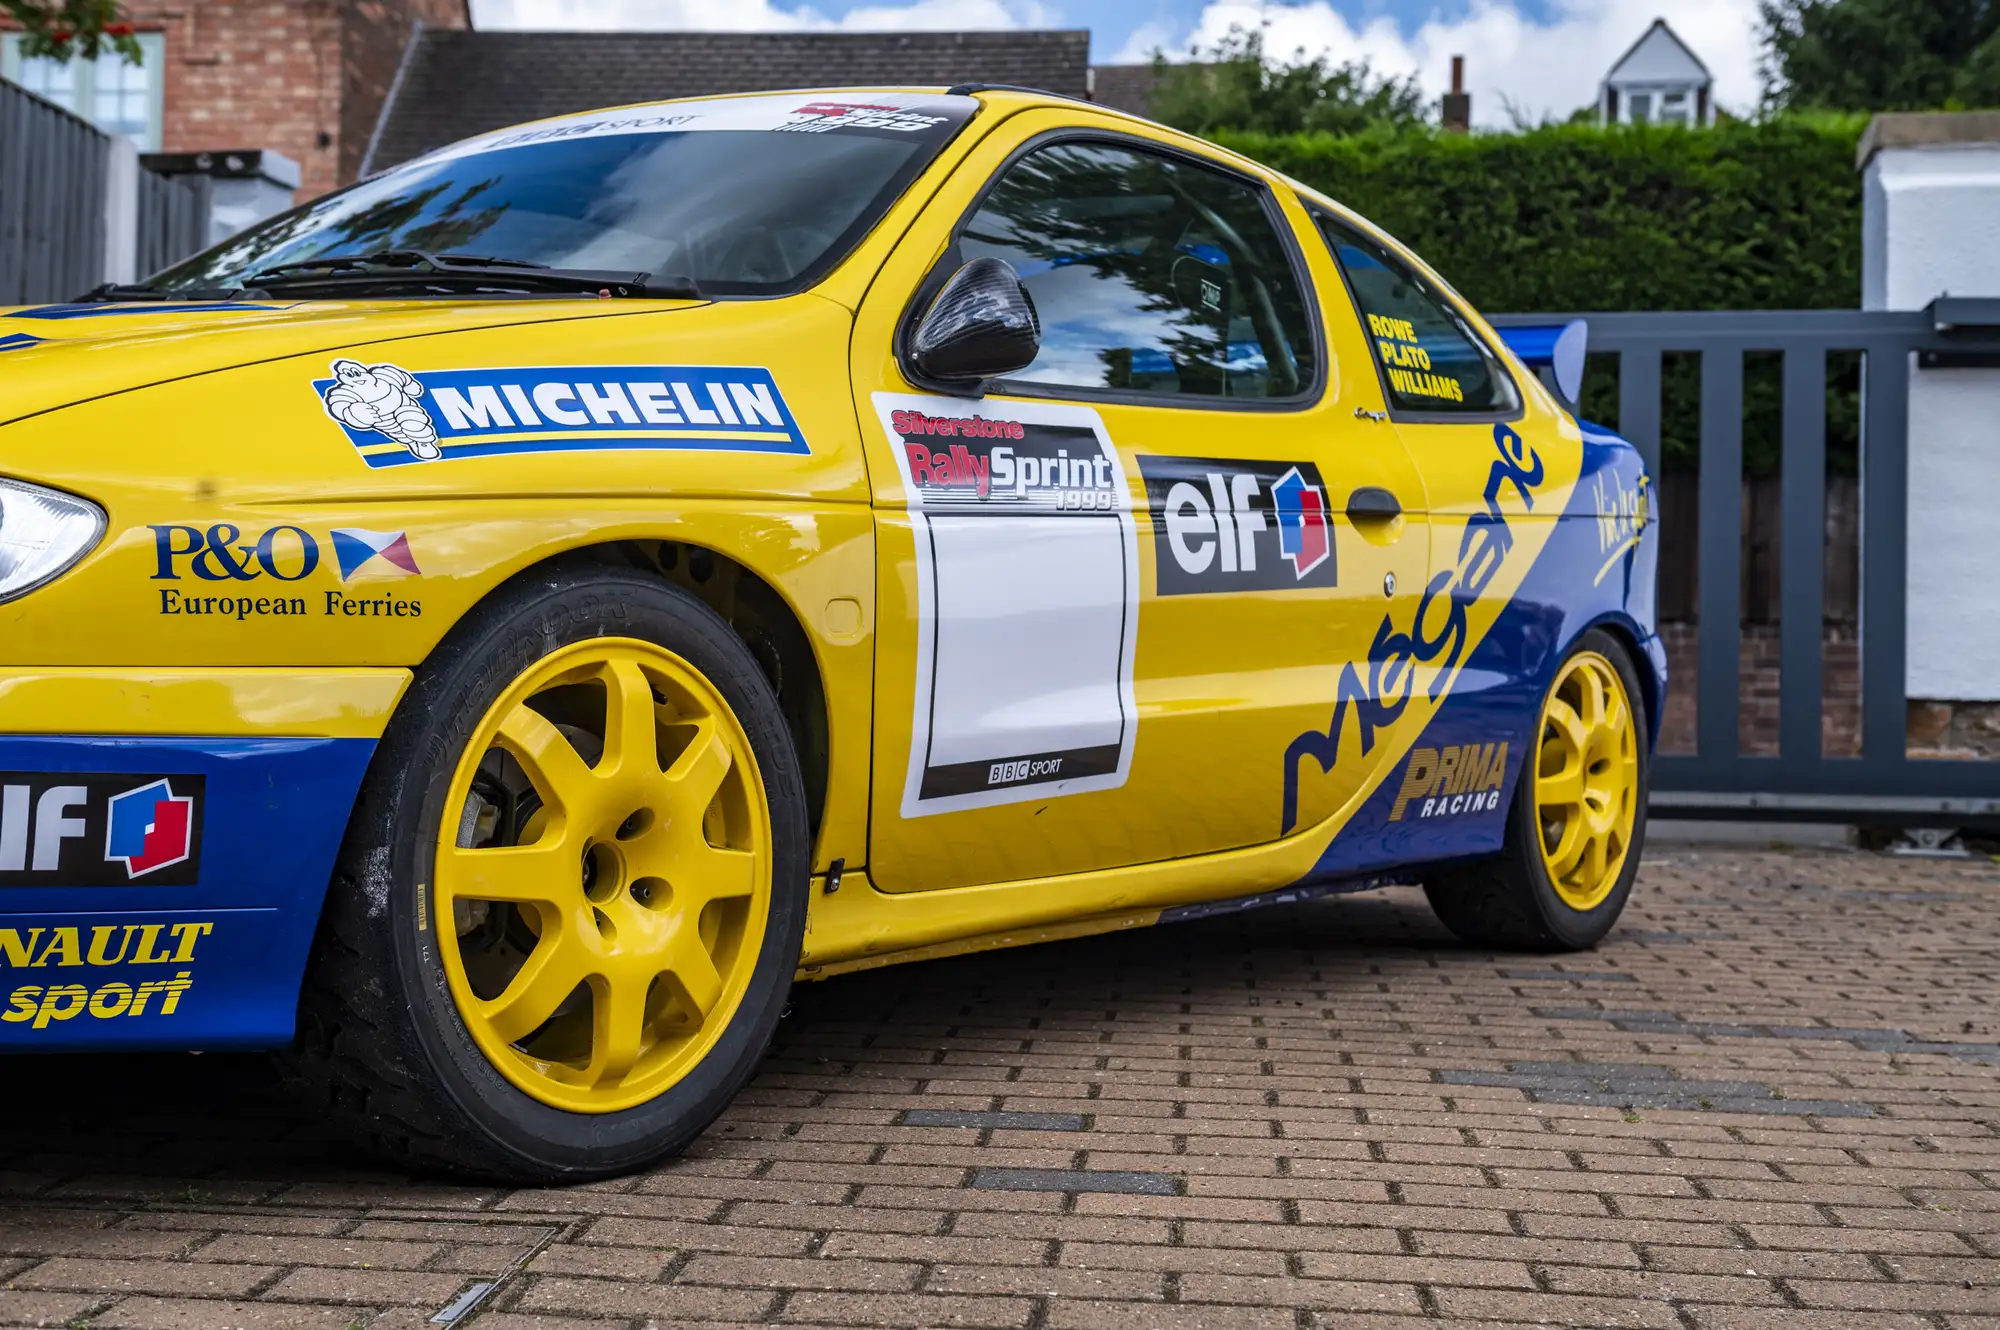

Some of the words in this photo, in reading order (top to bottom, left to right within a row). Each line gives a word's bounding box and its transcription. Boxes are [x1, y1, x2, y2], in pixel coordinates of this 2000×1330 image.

[1368, 314, 1418, 343] ROWE
[1379, 341, 1431, 371] PLATO
[1388, 368, 1463, 402] WILLIAMS
[431, 382, 785, 430] MICHELIN
[891, 409, 1025, 440] Silverstone
[1056, 489, 1114, 511] 1999
[1164, 473, 1267, 574] elf
[146, 523, 319, 582] P&O
[159, 589, 307, 620] European
[324, 591, 422, 617] Ferries
[990, 762, 1029, 783] BBC
[1030, 759, 1062, 776] SPORT
[1388, 741, 1509, 821] PRIMA
[1420, 791, 1500, 818] RACING
[1, 971, 193, 1029] sport
